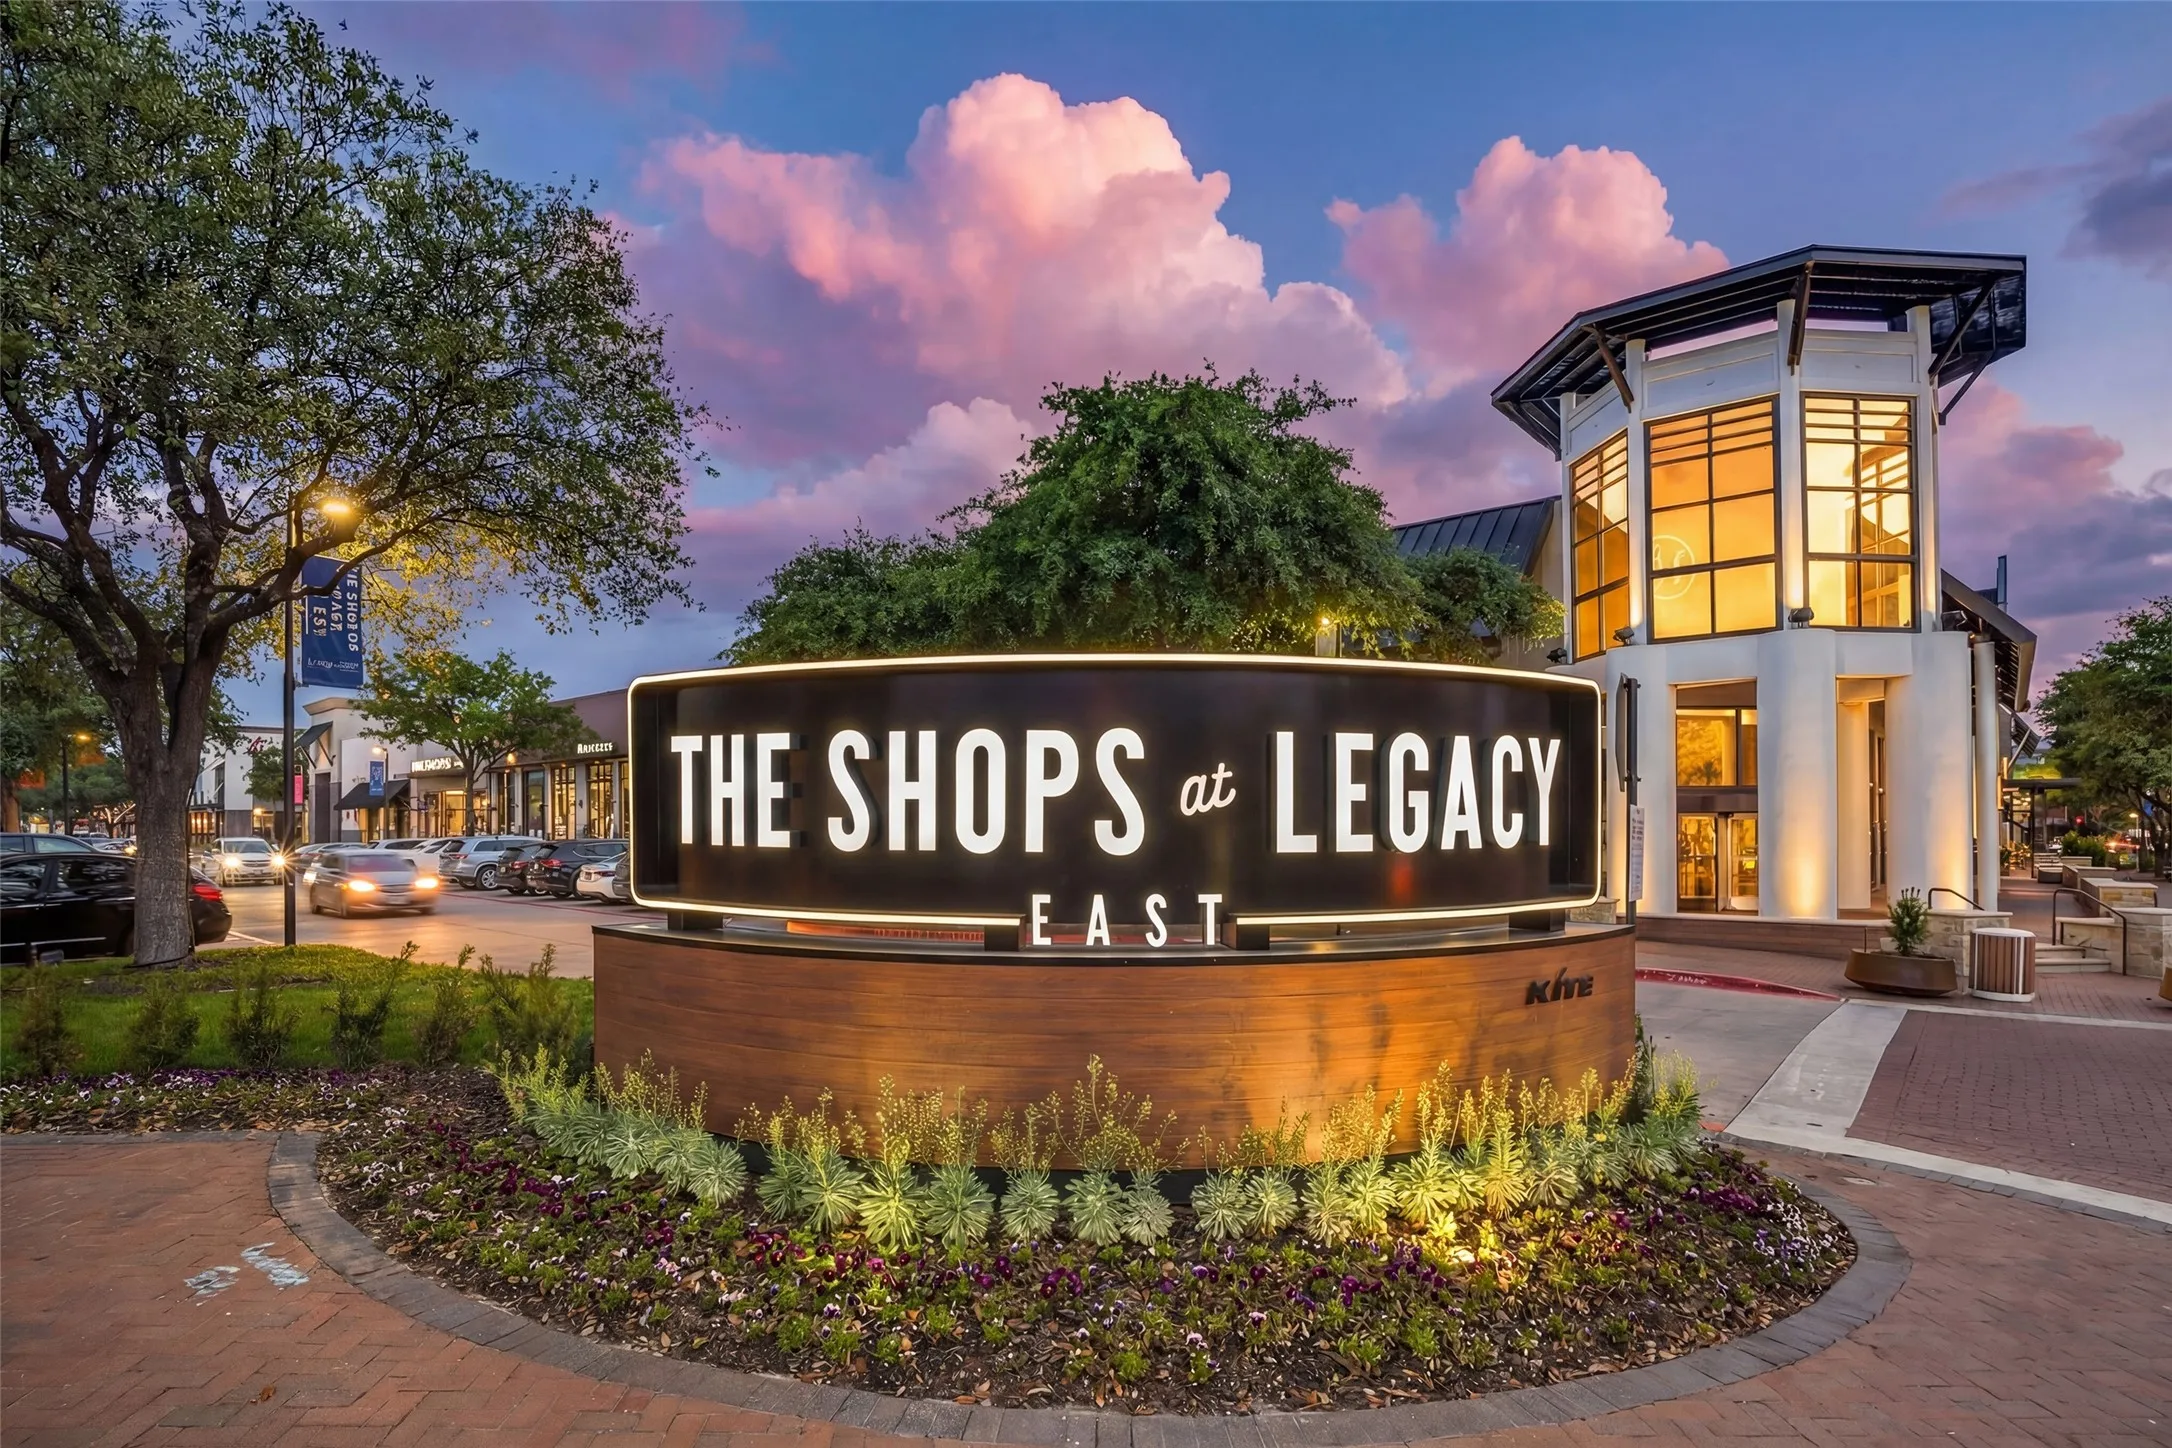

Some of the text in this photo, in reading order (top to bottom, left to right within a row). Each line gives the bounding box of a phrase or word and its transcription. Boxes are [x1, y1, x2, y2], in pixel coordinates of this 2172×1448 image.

[671, 733, 790, 847] THE
[828, 728, 1144, 855] SHOPS
[1181, 763, 1236, 816] at
[1277, 732, 1560, 853] LEGACY
[1033, 894, 1222, 946] EAST
